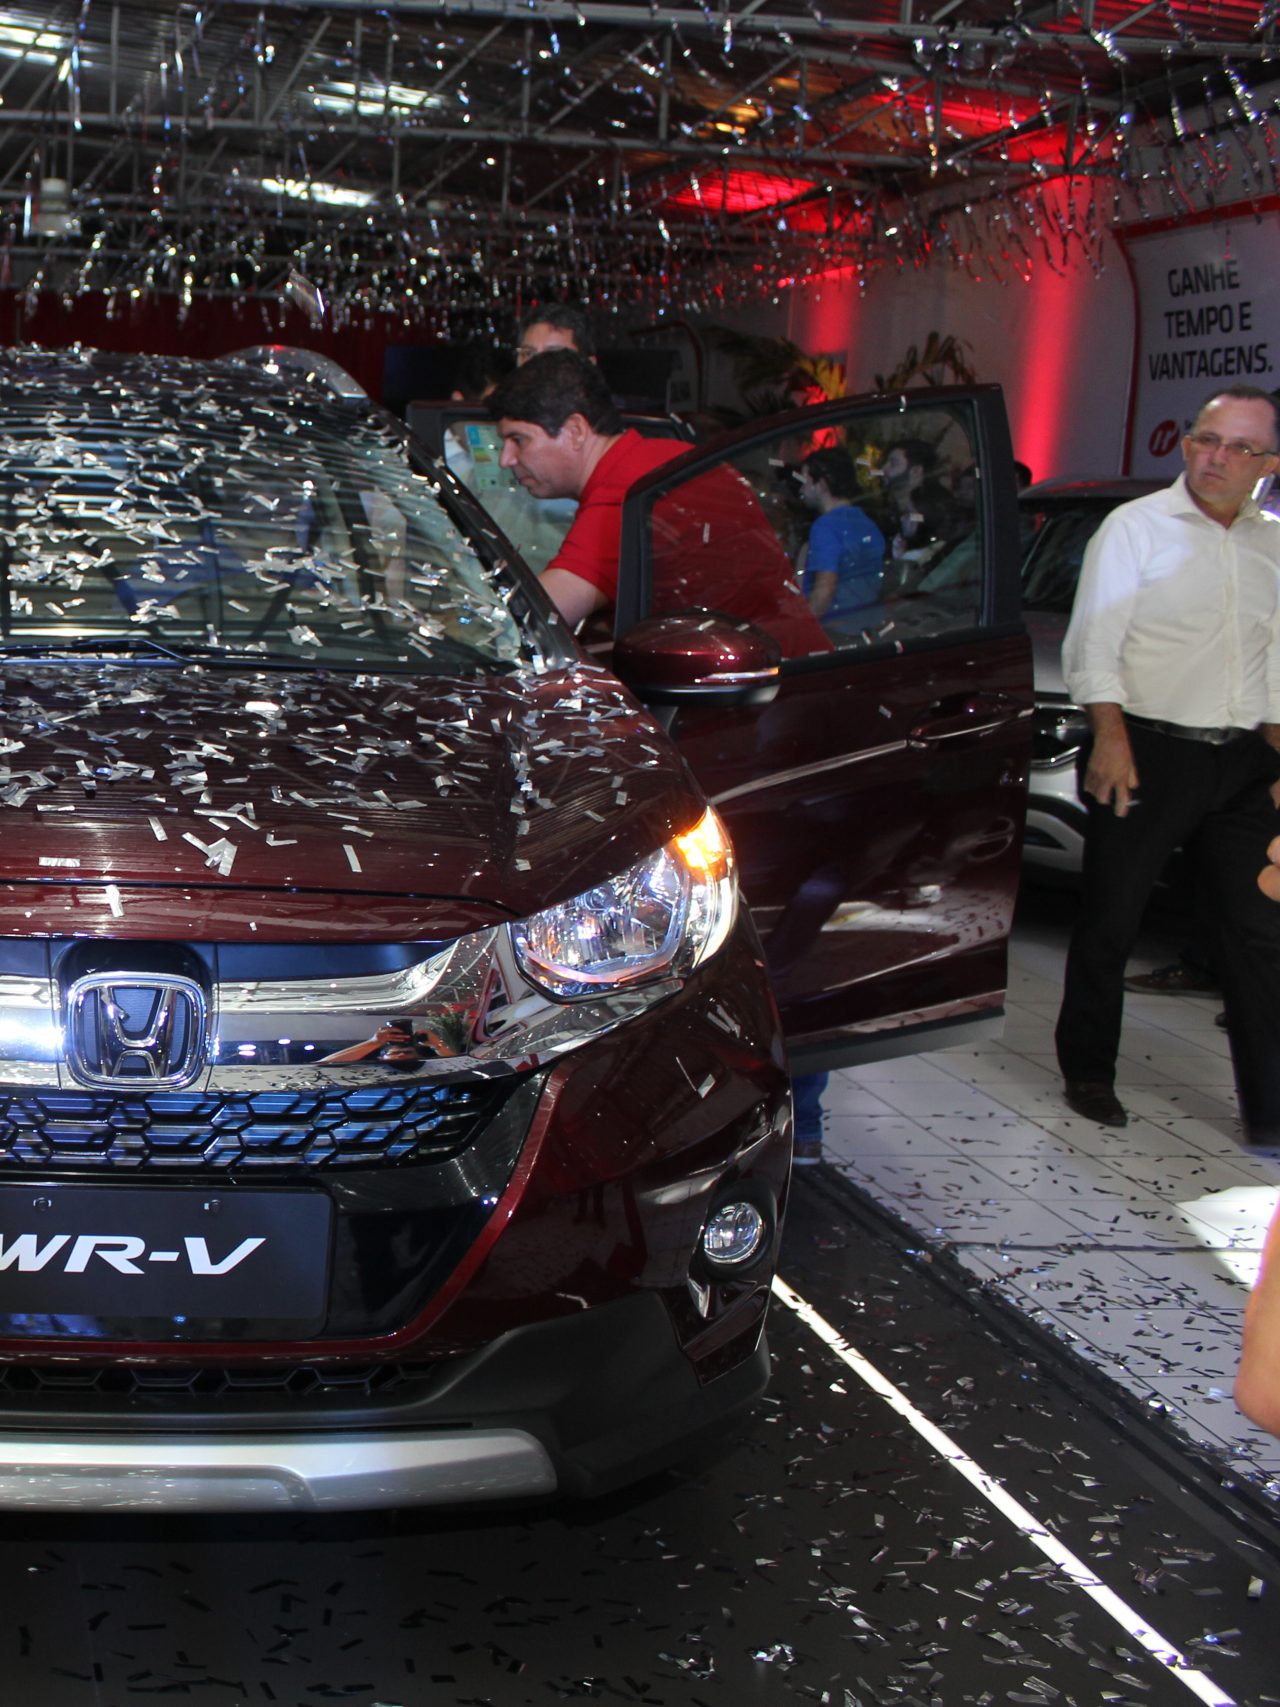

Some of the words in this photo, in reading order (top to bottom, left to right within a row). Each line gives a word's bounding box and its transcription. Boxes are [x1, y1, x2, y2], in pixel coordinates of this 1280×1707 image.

[1168, 260, 1240, 297] GANHE
[1164, 304, 1234, 339] TEMPO
[1239, 302, 1252, 331] E
[1148, 343, 1273, 381] VANTAGENS.
